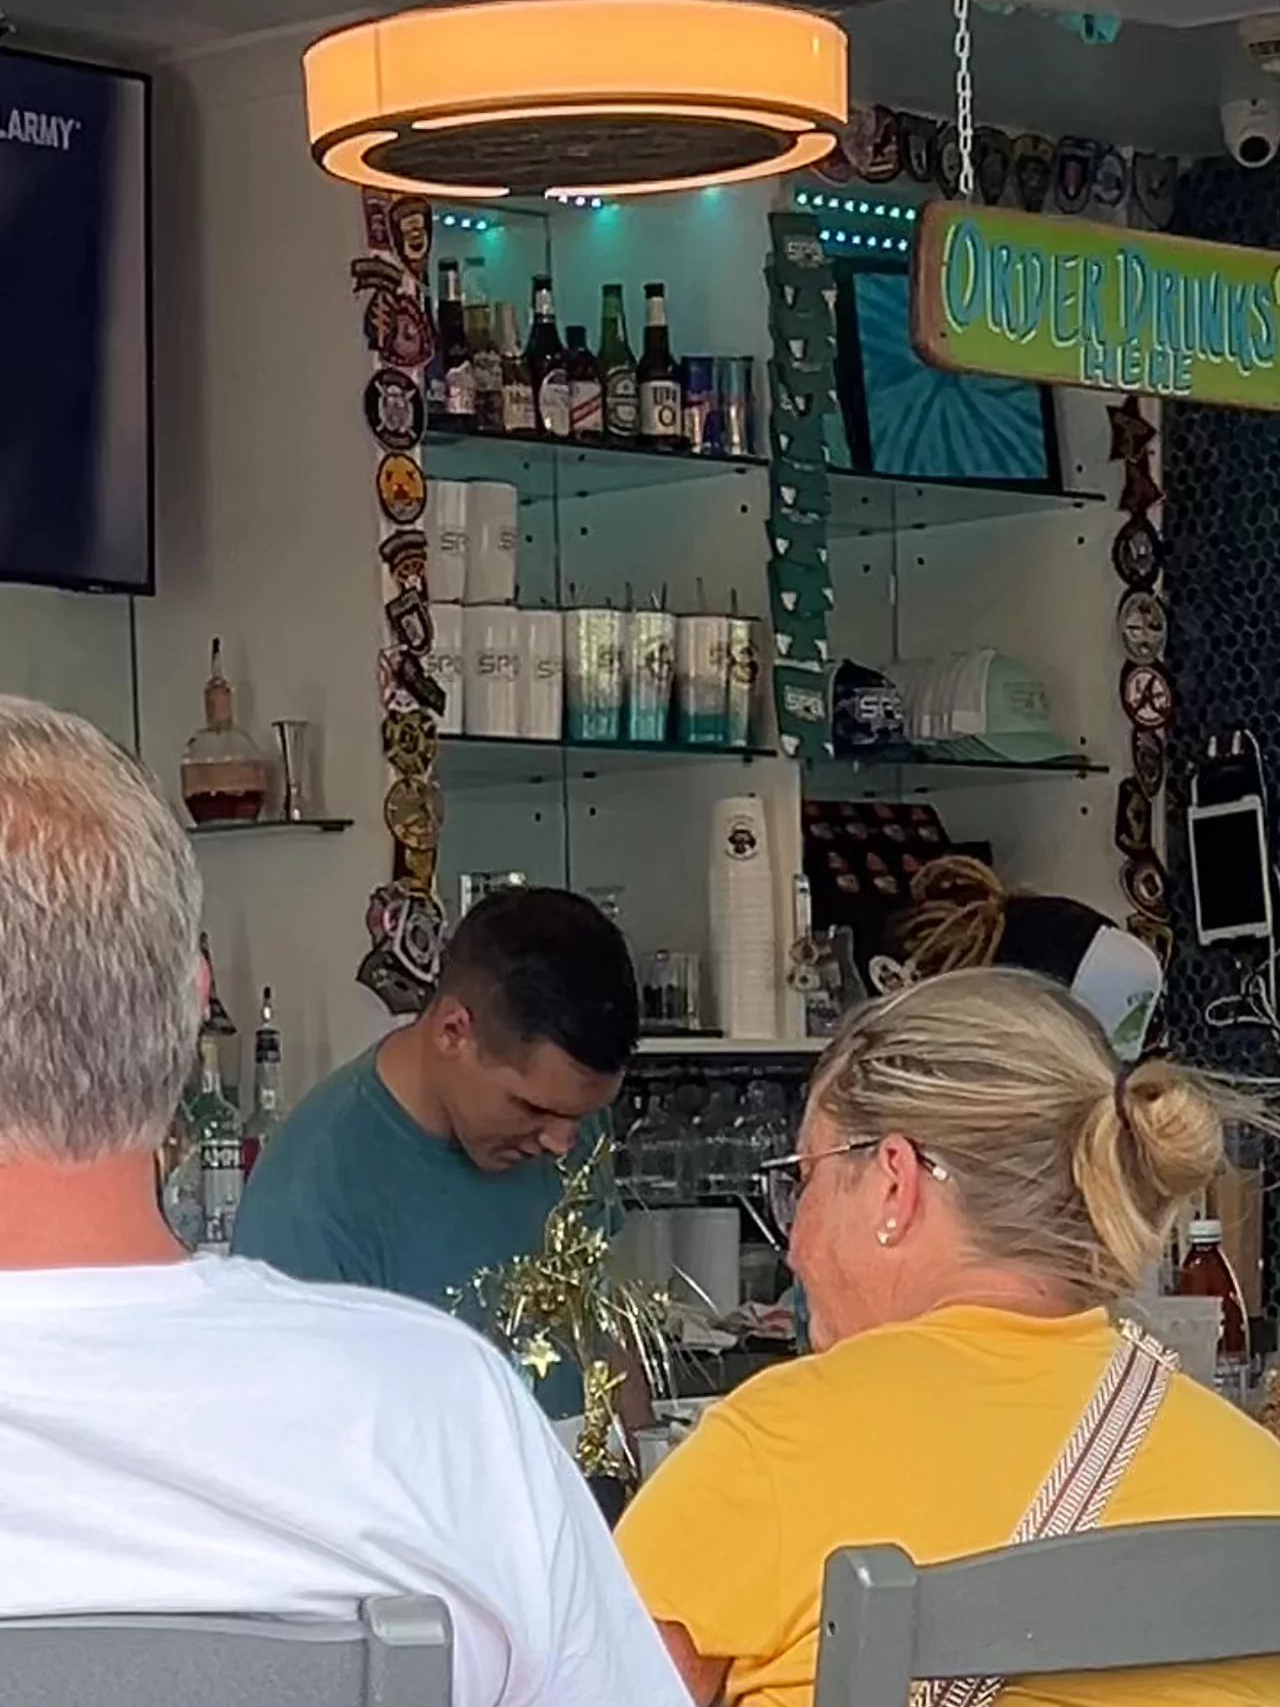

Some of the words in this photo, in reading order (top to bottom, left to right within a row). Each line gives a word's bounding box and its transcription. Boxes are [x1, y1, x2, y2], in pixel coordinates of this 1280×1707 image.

[940, 217, 1106, 348] ORDER
[1115, 240, 1280, 378] DRINKS
[1080, 339, 1194, 397] HERE
